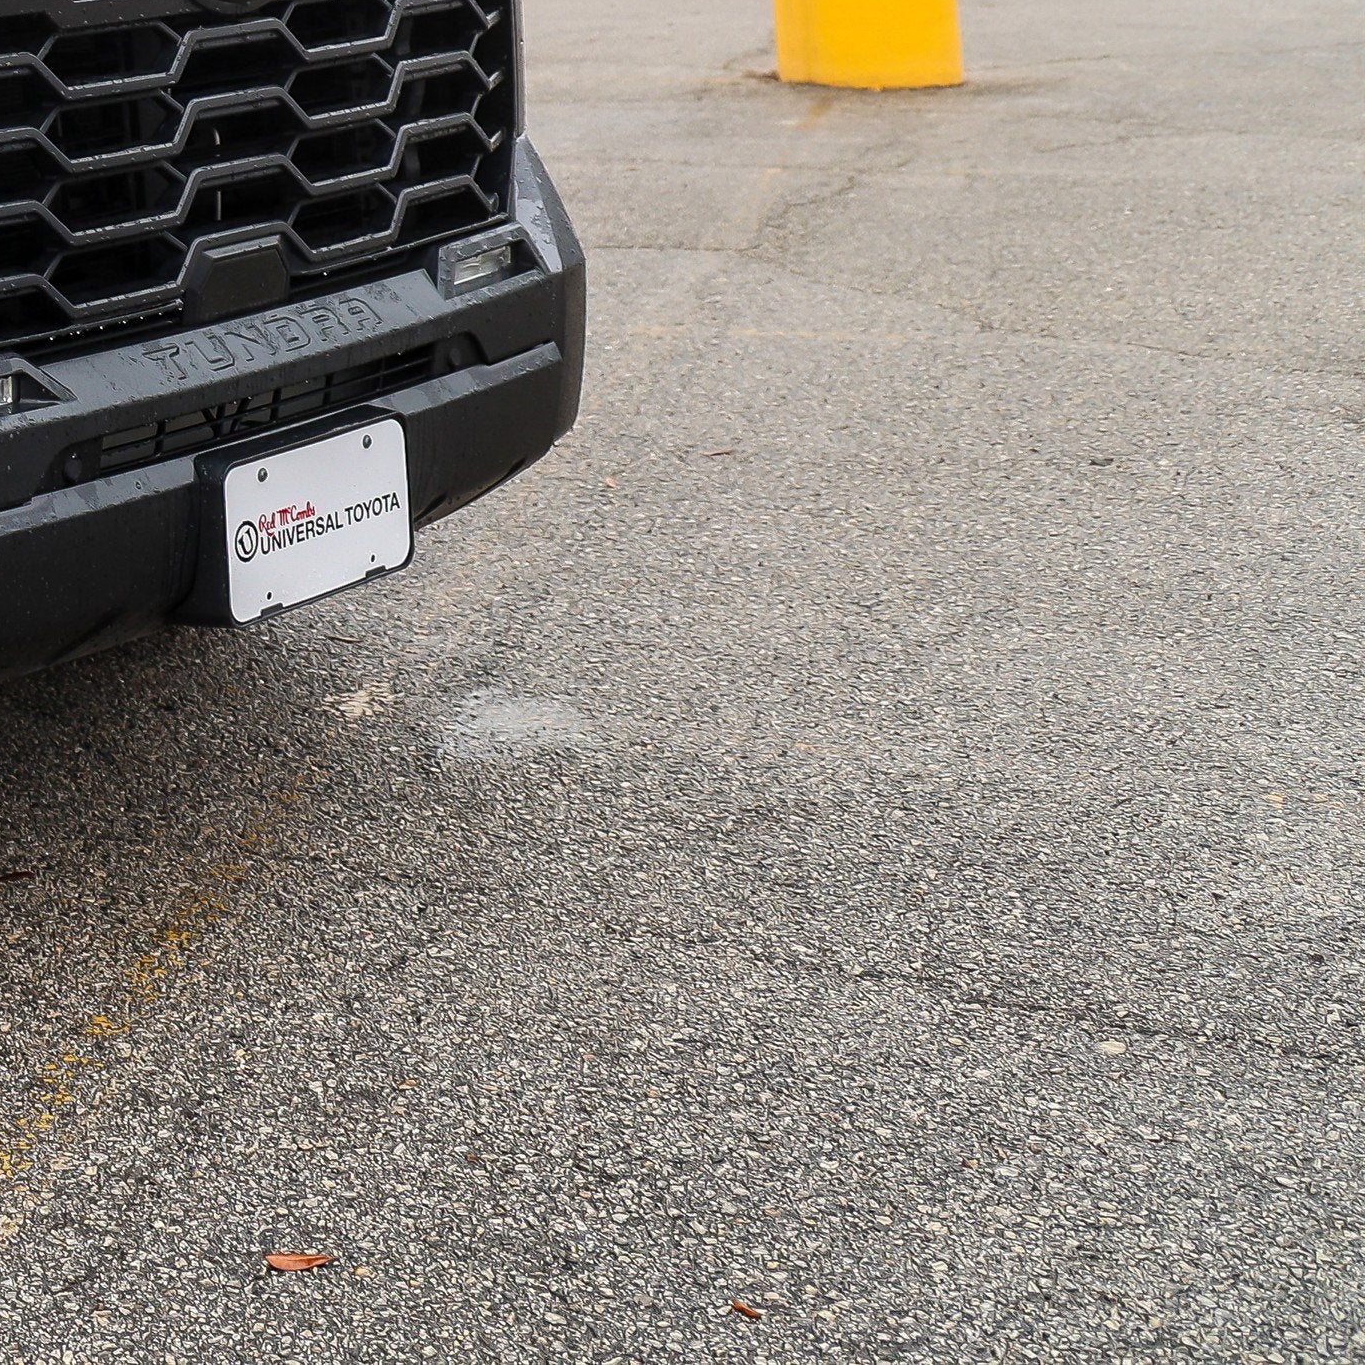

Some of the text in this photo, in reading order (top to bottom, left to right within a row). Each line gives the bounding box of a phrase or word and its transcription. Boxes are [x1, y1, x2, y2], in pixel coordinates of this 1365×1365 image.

[141, 295, 385, 381] TUNDRA
[260, 491, 401, 555] UNIVERSAL TOYOTA
